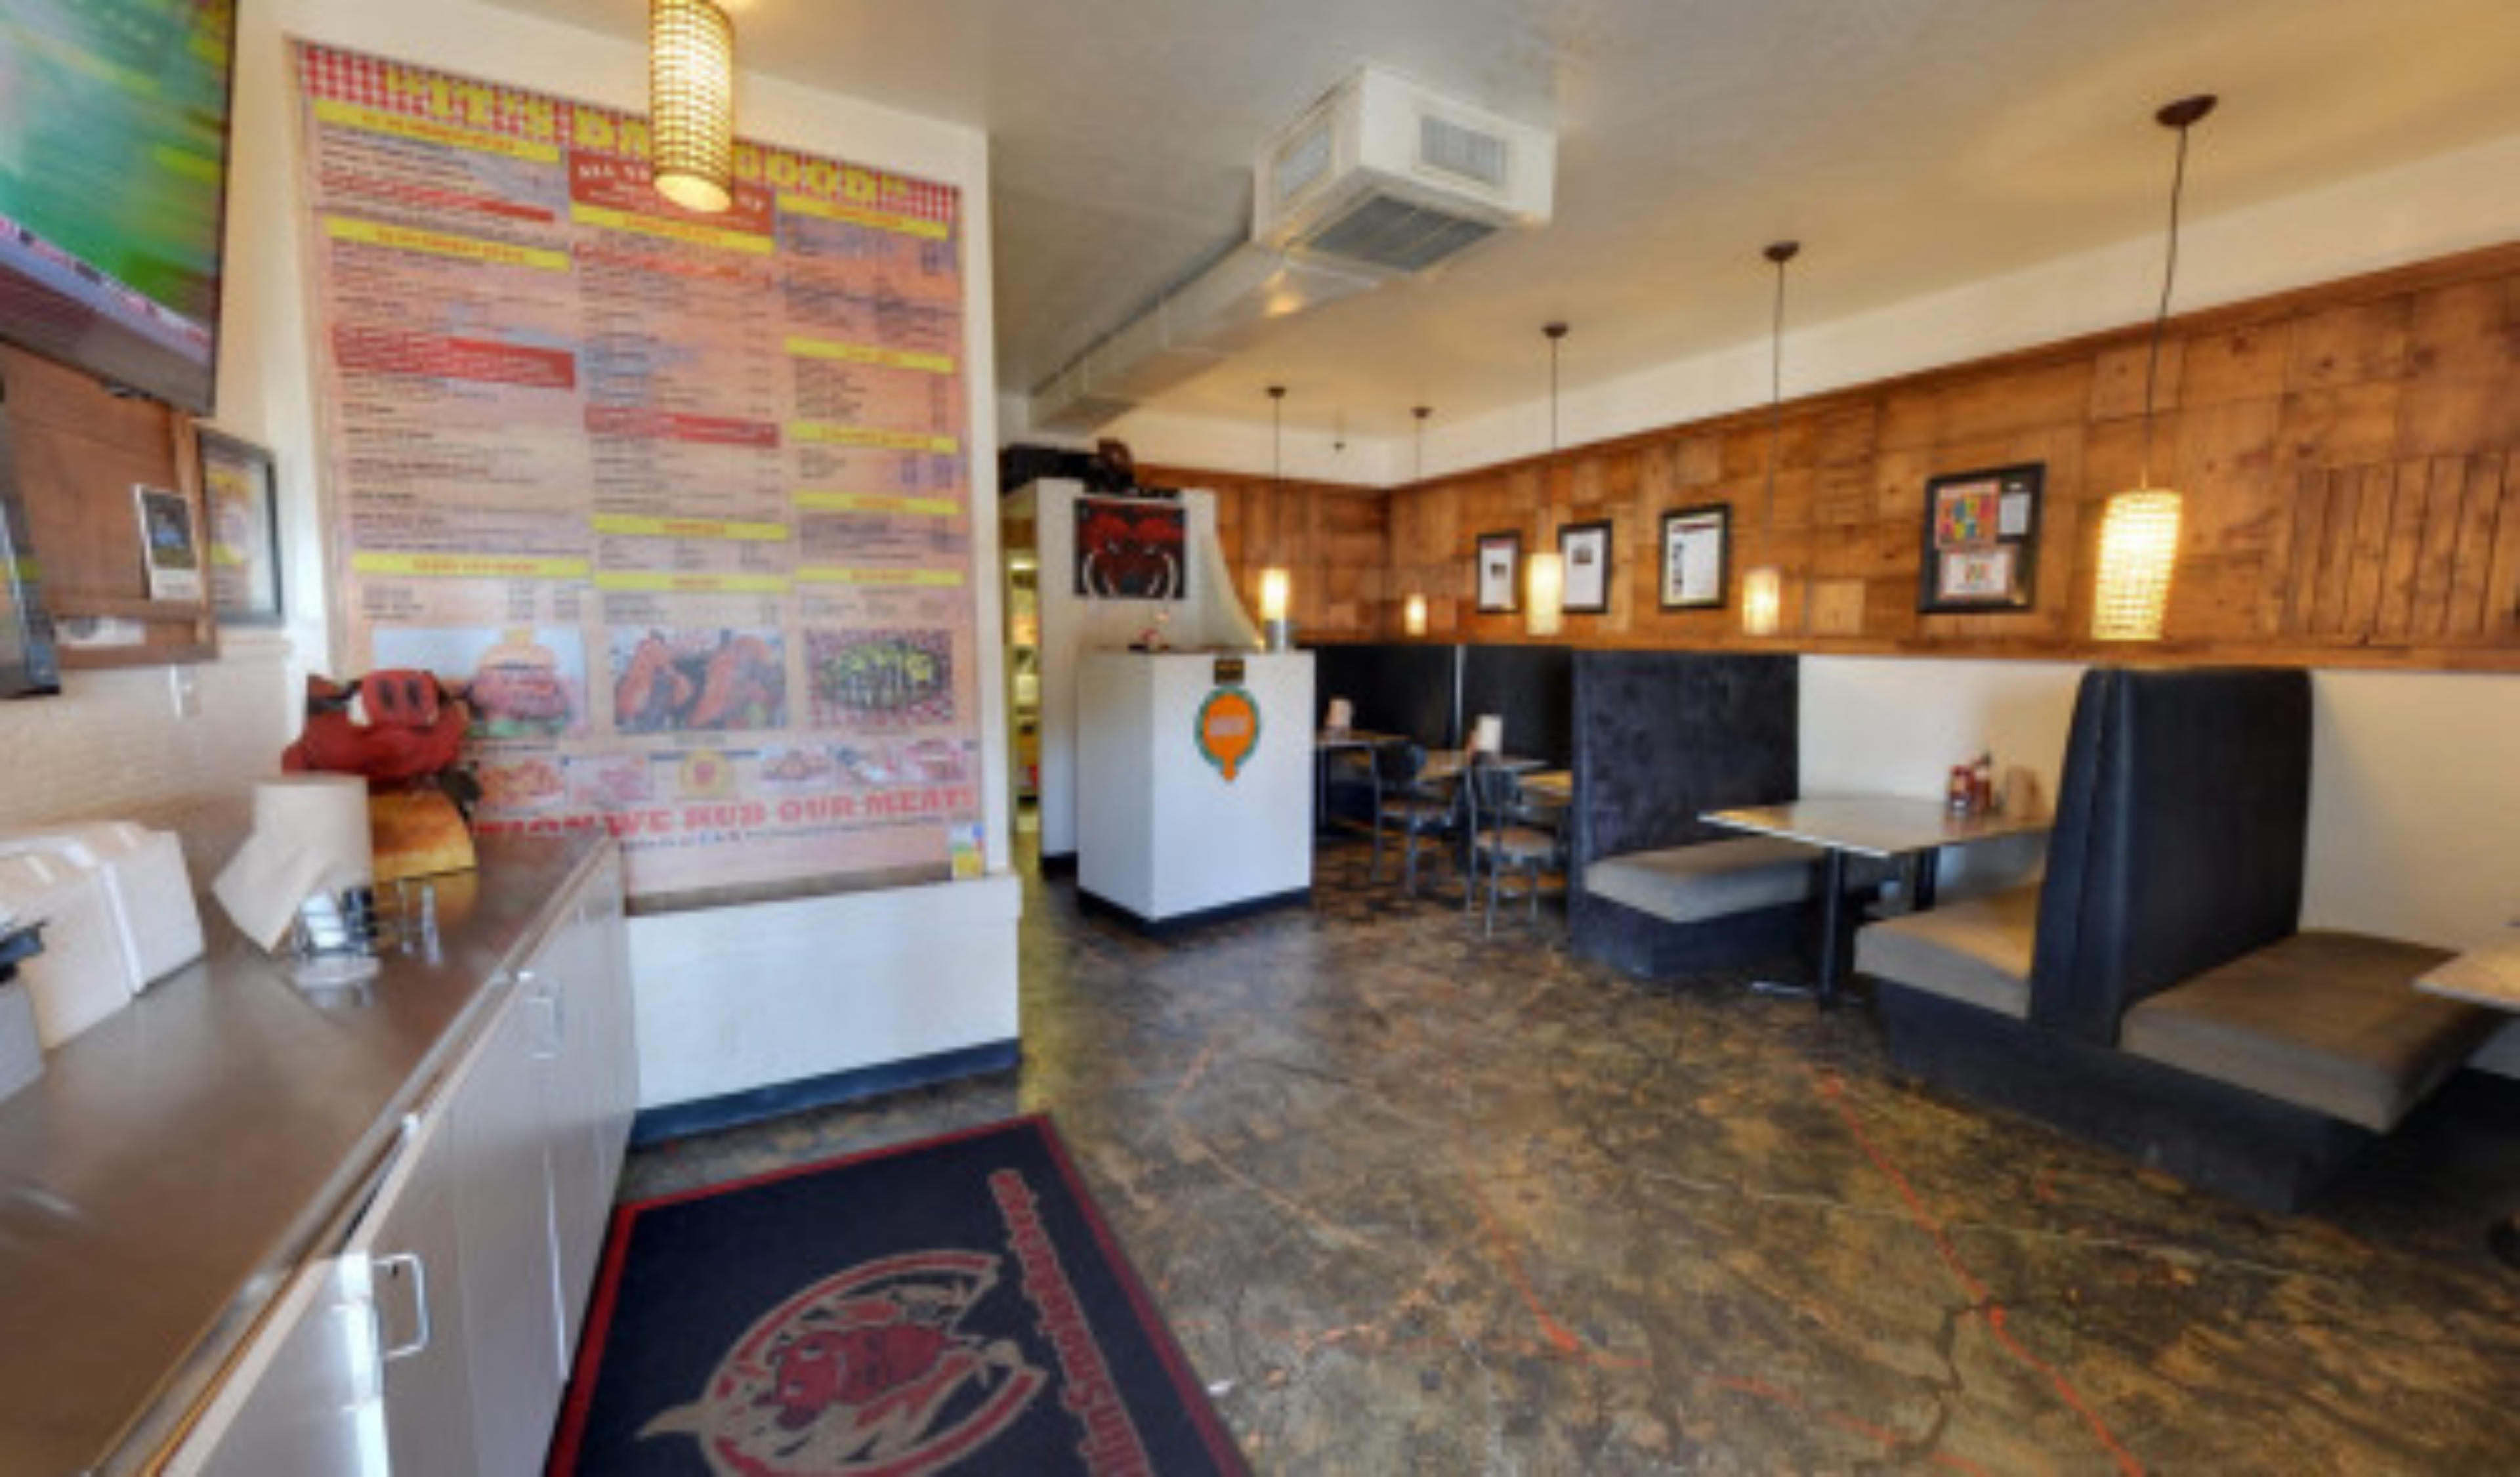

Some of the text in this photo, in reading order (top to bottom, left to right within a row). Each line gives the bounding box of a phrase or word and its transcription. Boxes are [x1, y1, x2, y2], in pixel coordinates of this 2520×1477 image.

[604, 809, 672, 839] WE
[684, 800, 767, 830] RUB
[776, 794, 854, 823] OUR
